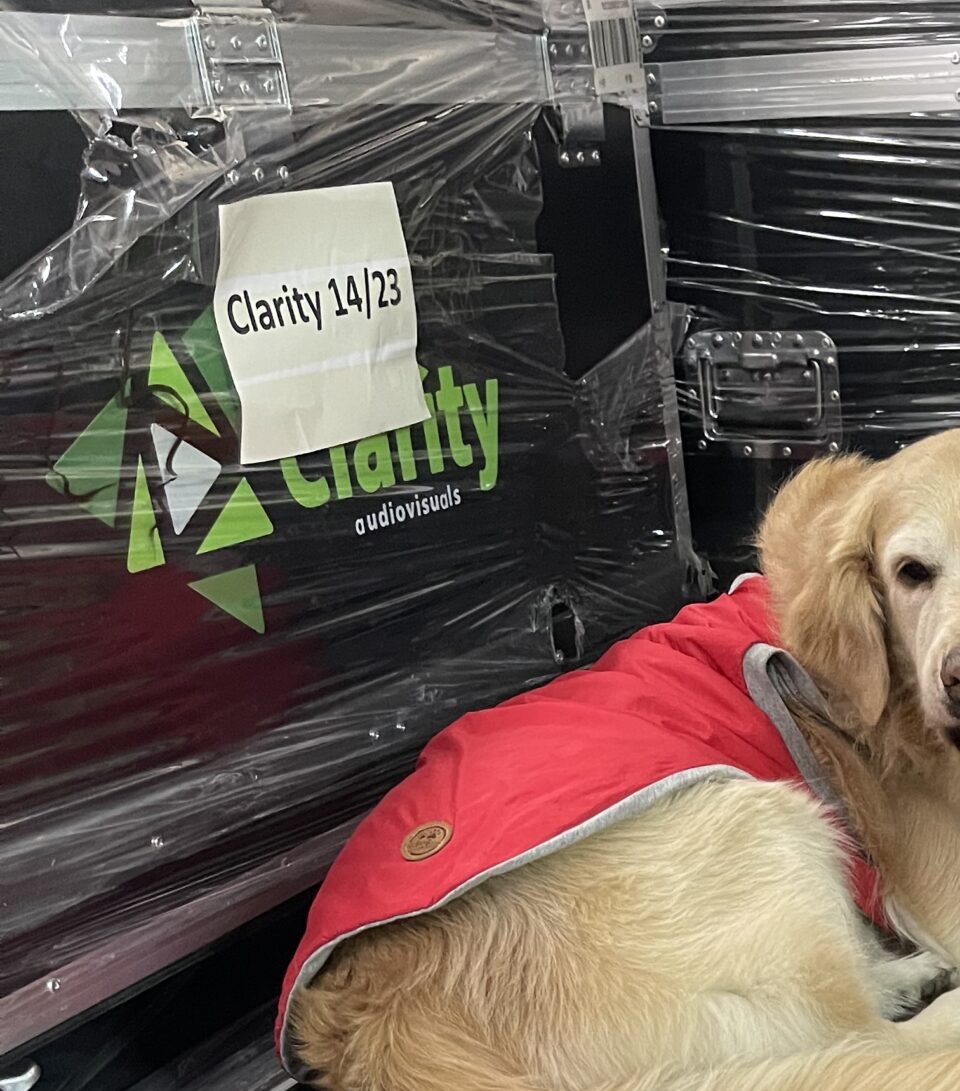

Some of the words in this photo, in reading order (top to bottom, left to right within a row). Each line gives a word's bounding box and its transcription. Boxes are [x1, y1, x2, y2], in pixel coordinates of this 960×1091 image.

[227, 284, 322, 335] Clarity
[328, 267, 402, 320] 14/23
[355, 484, 462, 536] audiovisuals
